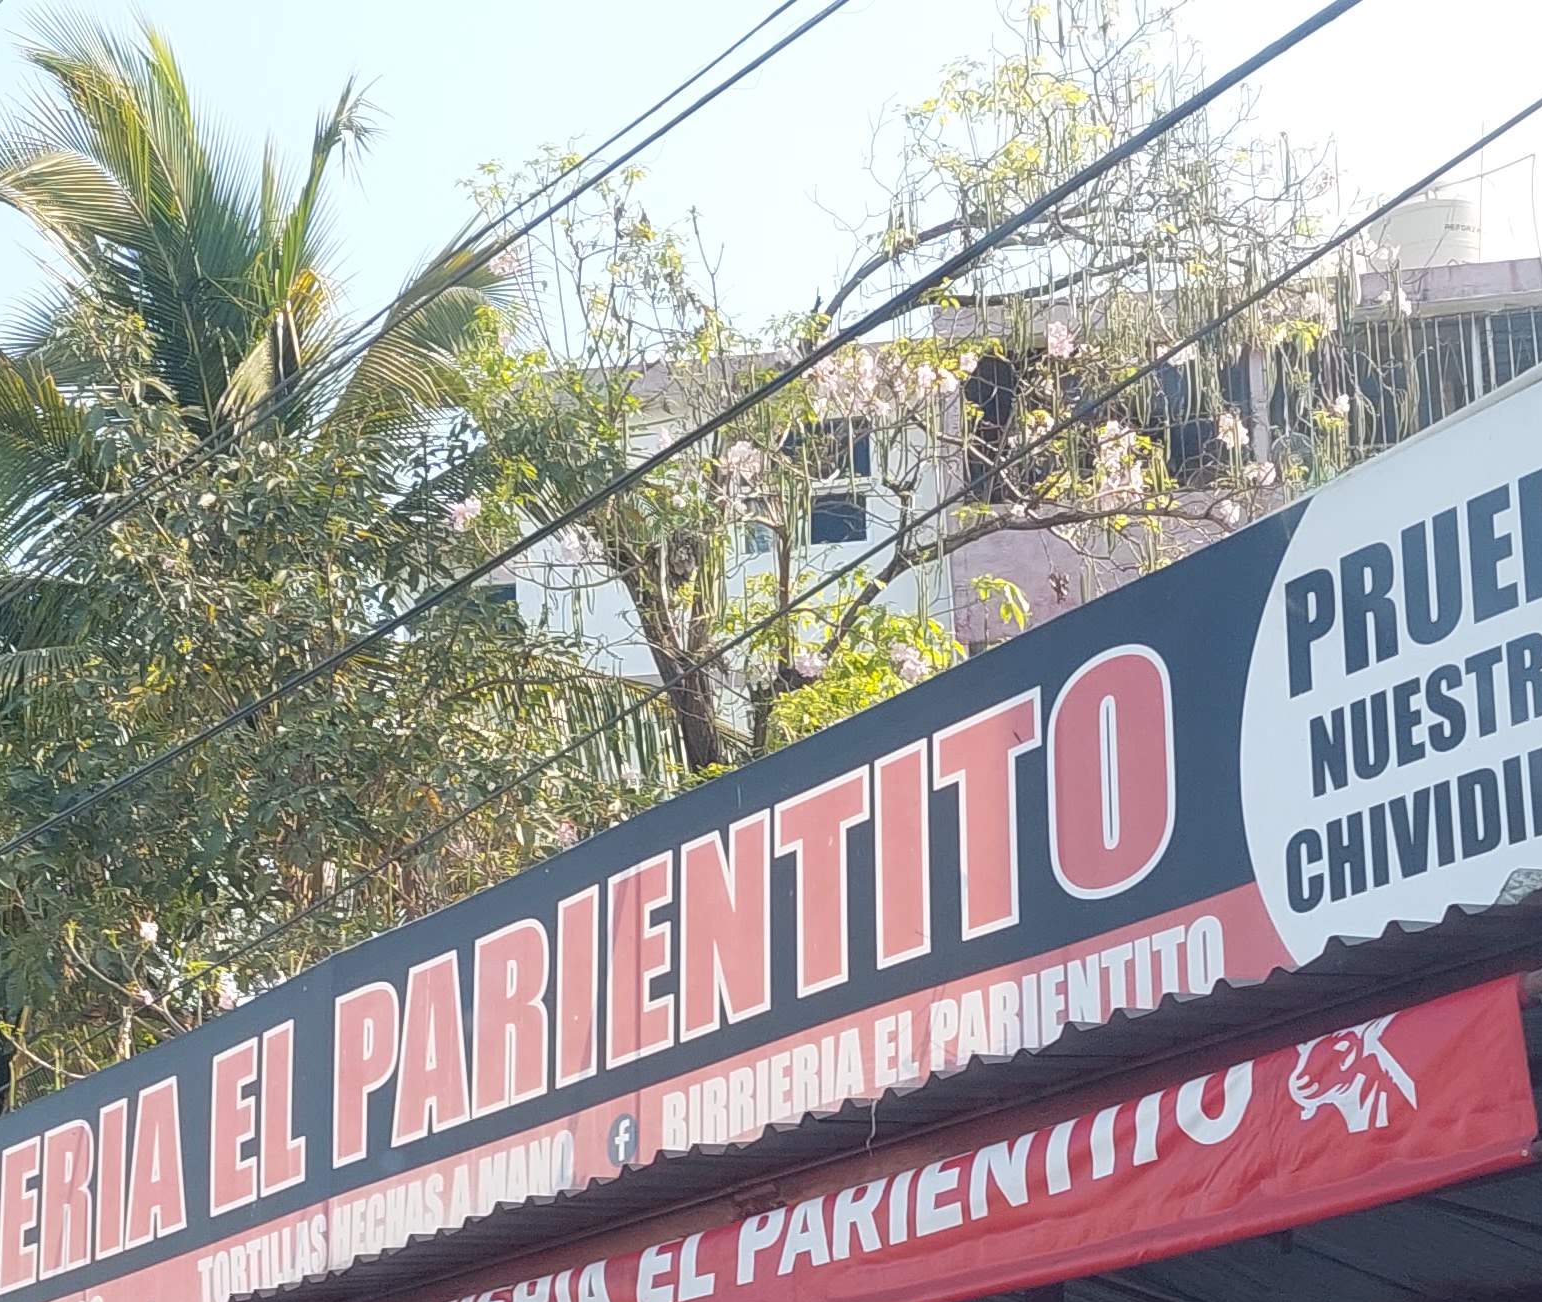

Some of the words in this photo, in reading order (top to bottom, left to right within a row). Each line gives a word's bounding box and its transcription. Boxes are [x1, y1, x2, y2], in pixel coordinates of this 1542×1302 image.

[210, 1019, 306, 1218] EL
[332, 643, 1176, 1169] PARIENTITO
[662, 1028, 865, 1152] BIRRIERIA
[875, 1010, 920, 1088] EL
[930, 916, 1225, 1072] PARIENTITO
[329, 1173, 445, 1270] HECHAS
[448, 1164, 471, 1229] A
[476, 1130, 574, 1216] MANO
